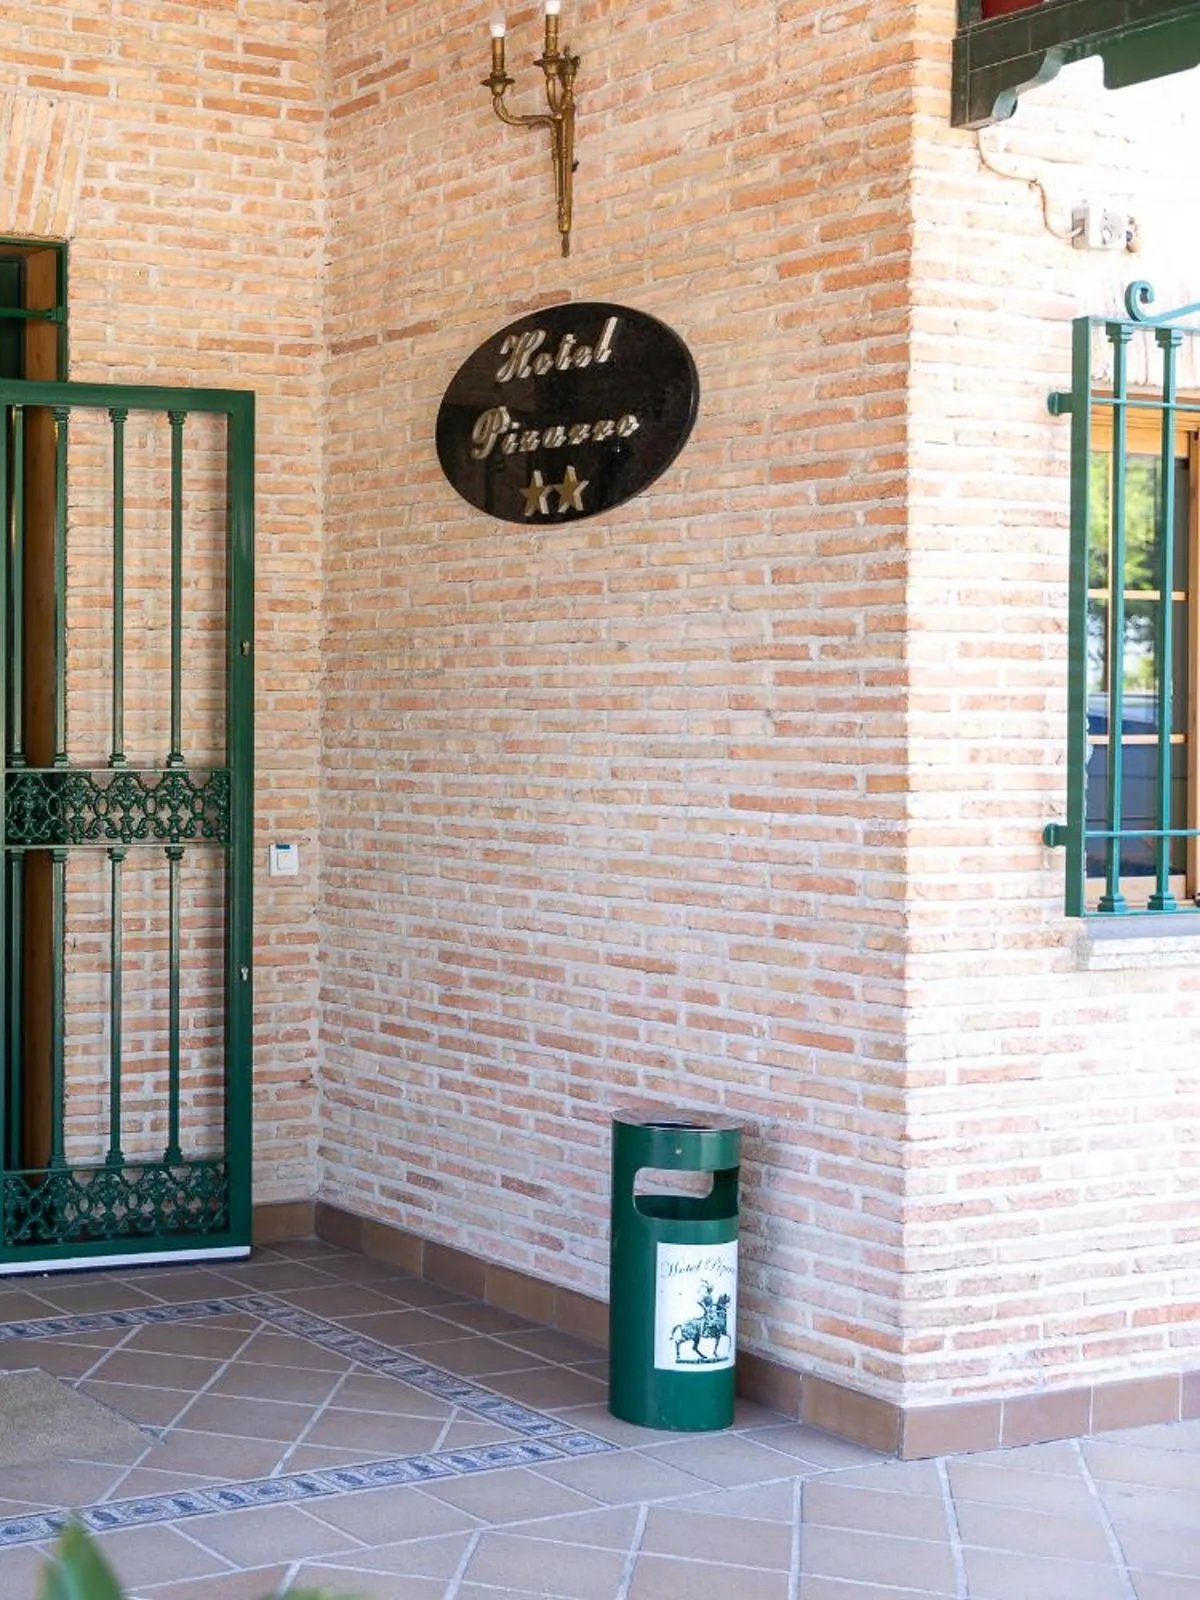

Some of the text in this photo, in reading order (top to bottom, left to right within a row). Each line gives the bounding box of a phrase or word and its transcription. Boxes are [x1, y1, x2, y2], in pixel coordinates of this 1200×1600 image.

[494, 315, 619, 384] Hotel
[470, 404, 641, 460] Pizarro
[660, 1259, 702, 1279] Hotel
